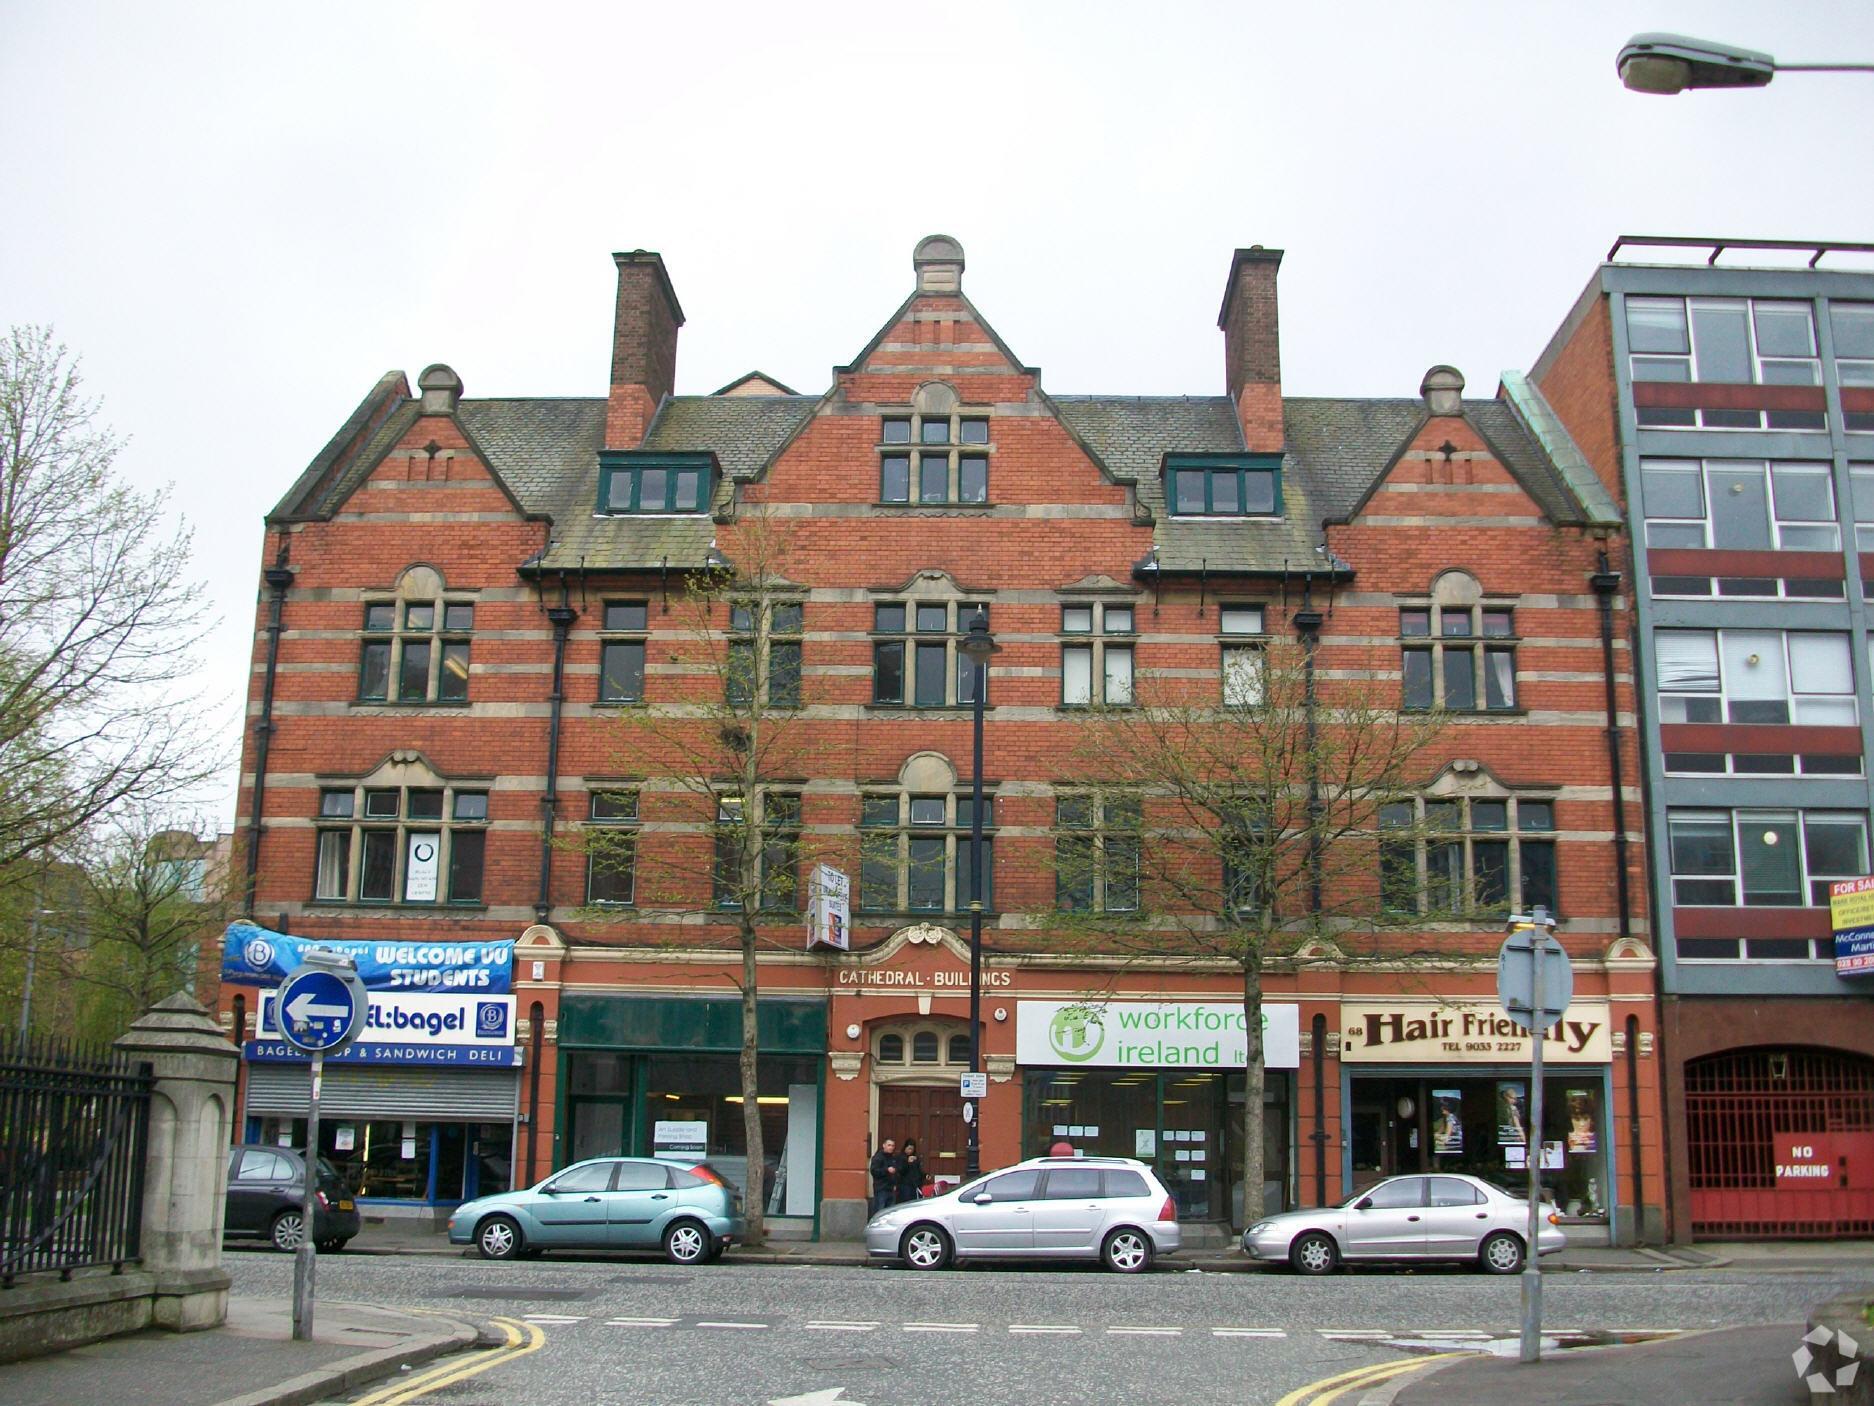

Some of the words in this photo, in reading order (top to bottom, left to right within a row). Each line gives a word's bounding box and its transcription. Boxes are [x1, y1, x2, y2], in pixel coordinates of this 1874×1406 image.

[1834, 882, 1856, 895] FOR
[376, 946, 475, 965] WELCOME
[481, 946, 509, 965] UU
[390, 968, 490, 987] STUDENTS
[839, 970, 924, 986] CATHEDRAL
[934, 972, 1011, 986] BUILINGS
[366, 1004, 465, 1036] EL:bagel
[1348, 1026, 1363, 1036] 68
[1362, 1011, 1453, 1047] Hair
[1462, 1012, 1603, 1054] Frienly
[1118, 1040, 1219, 1064] ireland
[1234, 1049, 1246, 1064] lt
[1442, 1042, 1462, 1051] TEL
[359, 1048, 368, 1058] &
[375, 1048, 457, 1060] SANDWICH
[469, 1050, 501, 1061] DELI
[1792, 1146, 1813, 1158] NO
[1775, 1165, 1829, 1177] PARKING
